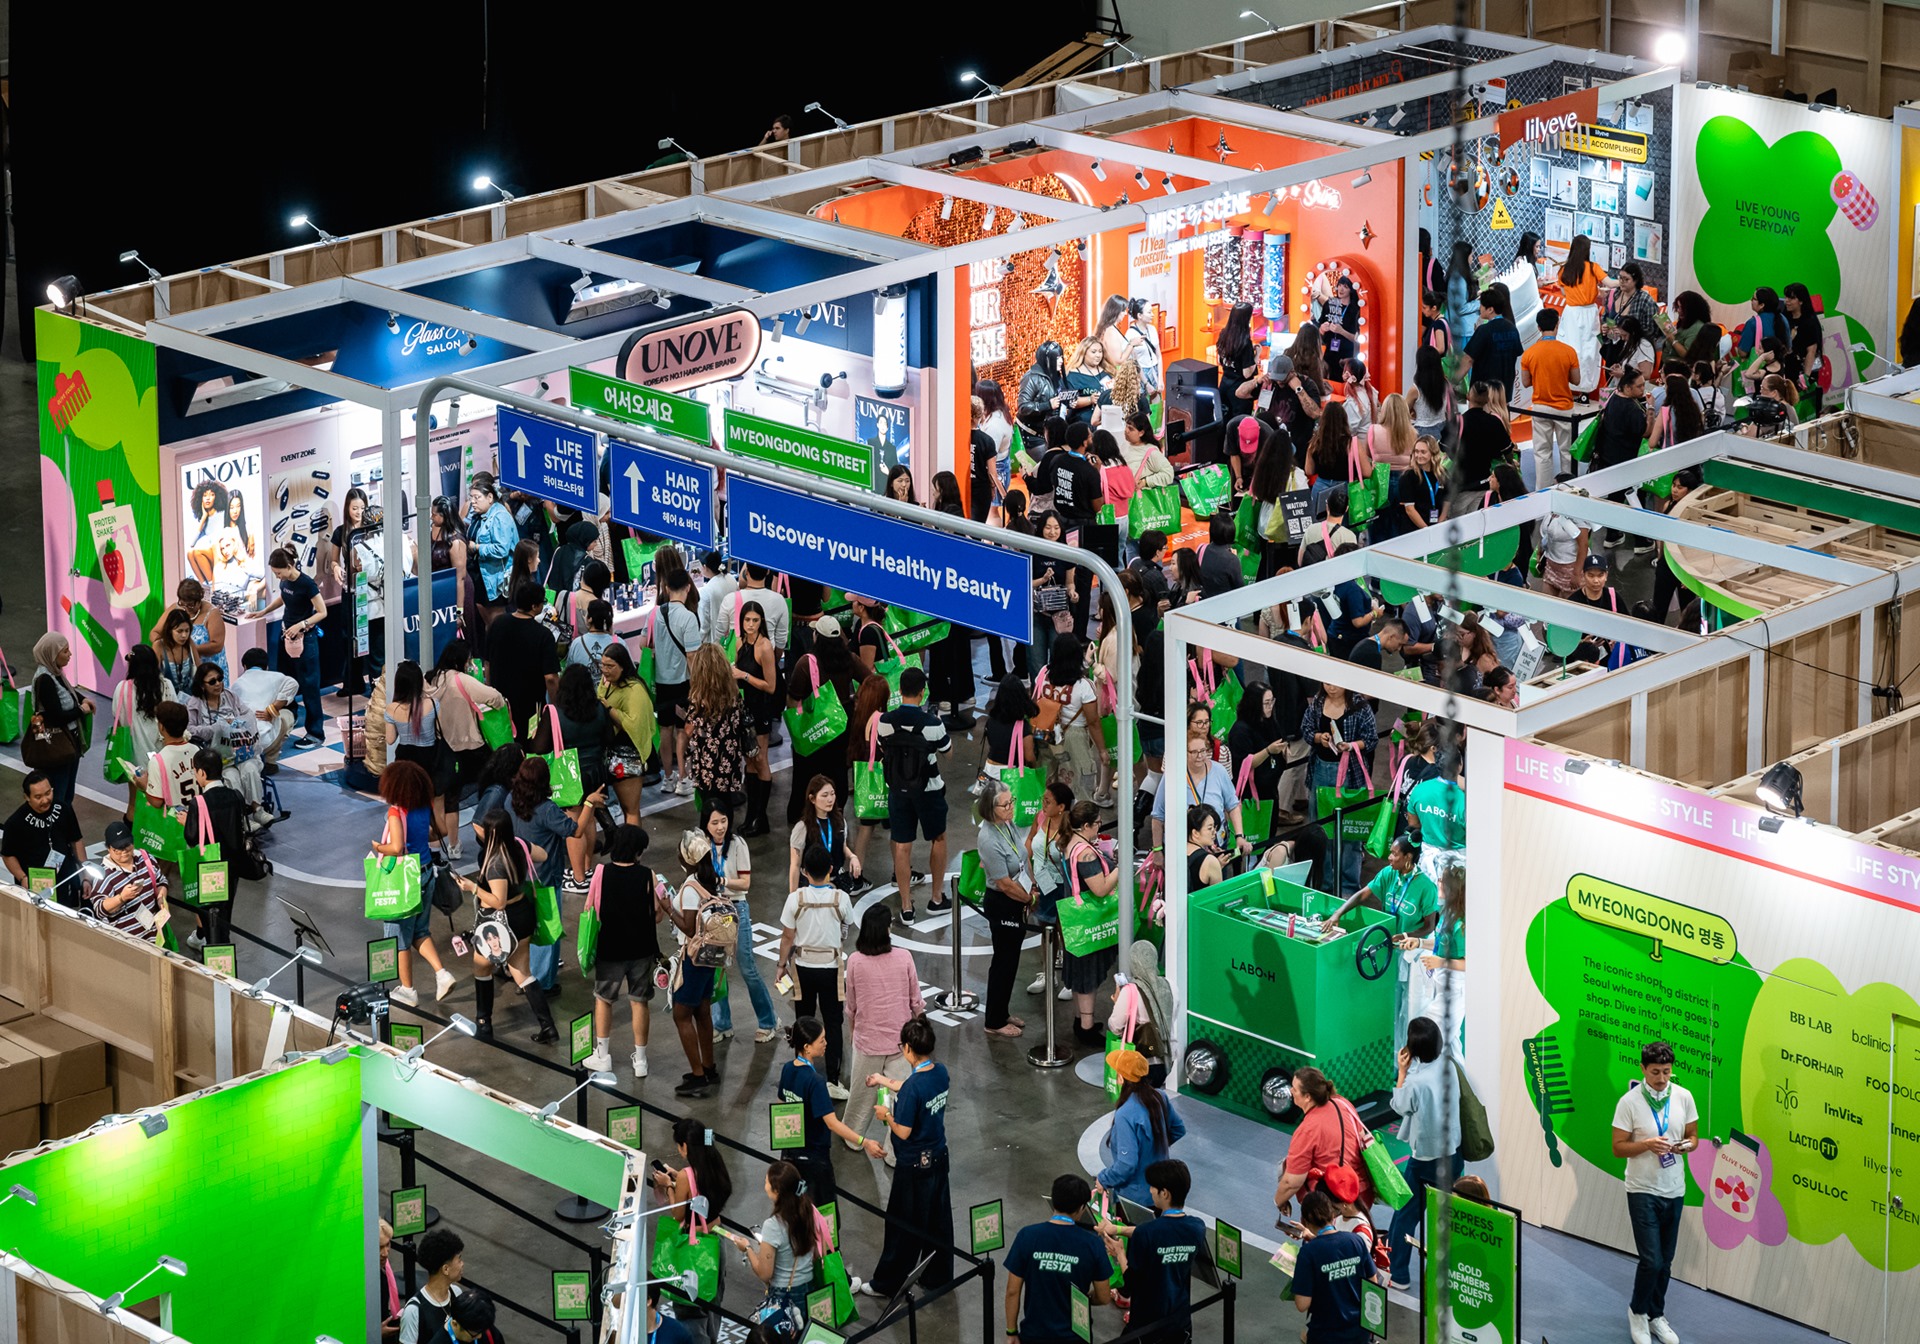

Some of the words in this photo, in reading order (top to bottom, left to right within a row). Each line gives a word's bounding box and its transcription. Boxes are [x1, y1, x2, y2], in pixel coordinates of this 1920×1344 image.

[1328, 88, 1346, 99] THE
[1348, 80, 1370, 96] ONLY
[1372, 72, 1390, 88] KEY
[1525, 111, 1578, 143] lilyeve
[1591, 140, 1642, 155] ACCOMPLISHED
[1149, 207, 1186, 236] MISE
[1736, 200, 1758, 214] LIVE
[1761, 205, 1800, 222] YOUNG
[1740, 216, 1796, 236] EVERYDAY
[1140, 237, 1149, 254] 11
[1140, 266, 1163, 278] WINNER
[426, 340, 461, 355] SALON
[640, 320, 742, 374] UNOVE
[643, 372, 669, 386] KOREA'S
[670, 370, 683, 381] NO.1
[683, 363, 714, 378] HAIRCARE
[714, 356, 737, 369] BRAND
[604, 387, 674, 424] 어서오세요
[859, 400, 905, 426] UNOVE
[280, 452, 300, 462] EVENT
[300, 448, 316, 458] ZONE
[556, 437, 584, 460] LIFE
[730, 425, 820, 462] MYEONGDONG
[822, 450, 866, 474] STREET
[186, 454, 260, 490] UNOVE
[544, 453, 584, 480] STYLE
[1057, 467, 1074, 482] SHINE
[543, 475, 584, 498] 라이프스타일
[666, 470, 700, 494] HAIR
[1058, 477, 1072, 490] YOUR
[1286, 500, 1308, 510] WAITING
[1292, 508, 1304, 516] LINE
[94, 515, 116, 528] PROTEIN
[96, 526, 114, 538] SHAKE
[662, 511, 677, 528] 헤어
[678, 517, 685, 528] &
[686, 518, 702, 534] 바디
[749, 511, 824, 552] Discover
[828, 537, 868, 565] your
[871, 546, 942, 590] Healthy
[945, 567, 1012, 610] Beauty
[912, 629, 930, 642] ESTA
[808, 726, 830, 742] FESTA
[1516, 754, 1548, 780] LIFE
[1552, 766, 1585, 789] STY
[1660, 798, 1713, 829] STYLE
[874, 800, 888, 808] FES
[1344, 826, 1370, 834] FESTA
[142, 836, 162, 852] FESTA
[375, 896, 397, 906] FESTA
[1084, 925, 1101, 935] OLIVE
[1102, 919, 1119, 930] YOUNG
[1578, 890, 1694, 940] MYEONGDONG
[1698, 928, 1725, 950] 명동
[1092, 928, 1117, 942] FESTA
[1584, 956, 1601, 970] The
[1604, 962, 1633, 979] iconic
[1675, 986, 1709, 1009] district
[1583, 974, 1610, 990] Seoul
[1612, 982, 1644, 1000] where
[1684, 1010, 1708, 1026] goes
[1586, 992, 1612, 1008] shop.
[1614, 1000, 1636, 1015] Dive
[1638, 1006, 1658, 1020] into
[1672, 1021, 1716, 1047] K-Beauty
[1790, 1010, 1806, 1026] BB
[1808, 1017, 1832, 1034] LAB
[1578, 1008, 1620, 1026] paradise
[1622, 1021, 1640, 1032] and
[1643, 1025, 1662, 1038] find
[1680, 1043, 1723, 1066] everyday
[1852, 1029, 1896, 1054] b.clinicx
[1587, 1027, 1636, 1048] essentials
[1673, 1058, 1694, 1074] ody,
[1696, 1065, 1714, 1079] and
[1618, 1052, 1641, 1066] inne
[1781, 1048, 1844, 1079] Dr.FORHAIR
[1528, 1042, 1540, 1066] OLIVE
[1534, 1067, 1546, 1094] YOUNG
[1789, 1131, 1818, 1150] LACTO
[1821, 1142, 1837, 1157] FIT
[1722, 1154, 1738, 1168] OLIVE
[1740, 1164, 1759, 1180] YOUNG
[1864, 1156, 1902, 1178] lilyeve
[1792, 1174, 1848, 1202] OSULLOC
[1870, 1200, 1920, 1226] TEAZEN
[1032, 1251, 1054, 1262] OLIVE
[1054, 1253, 1080, 1265] YOUNG
[1156, 1246, 1174, 1254] OLIVE
[1175, 1244, 1196, 1252] YOUNG
[1161, 1252, 1189, 1264] FESTA
[1038, 1260, 1072, 1274] FESTA
[1320, 1262, 1340, 1273] OLIVE
[1340, 1256, 1361, 1266] YOUNG
[1328, 1266, 1357, 1282] FESTA
[1458, 1262, 1482, 1278] GOLD
[1448, 1270, 1490, 1292] MEMBERS
[1458, 1294, 1482, 1309] ONLY
[1460, 1284, 1494, 1303] GUESTS
